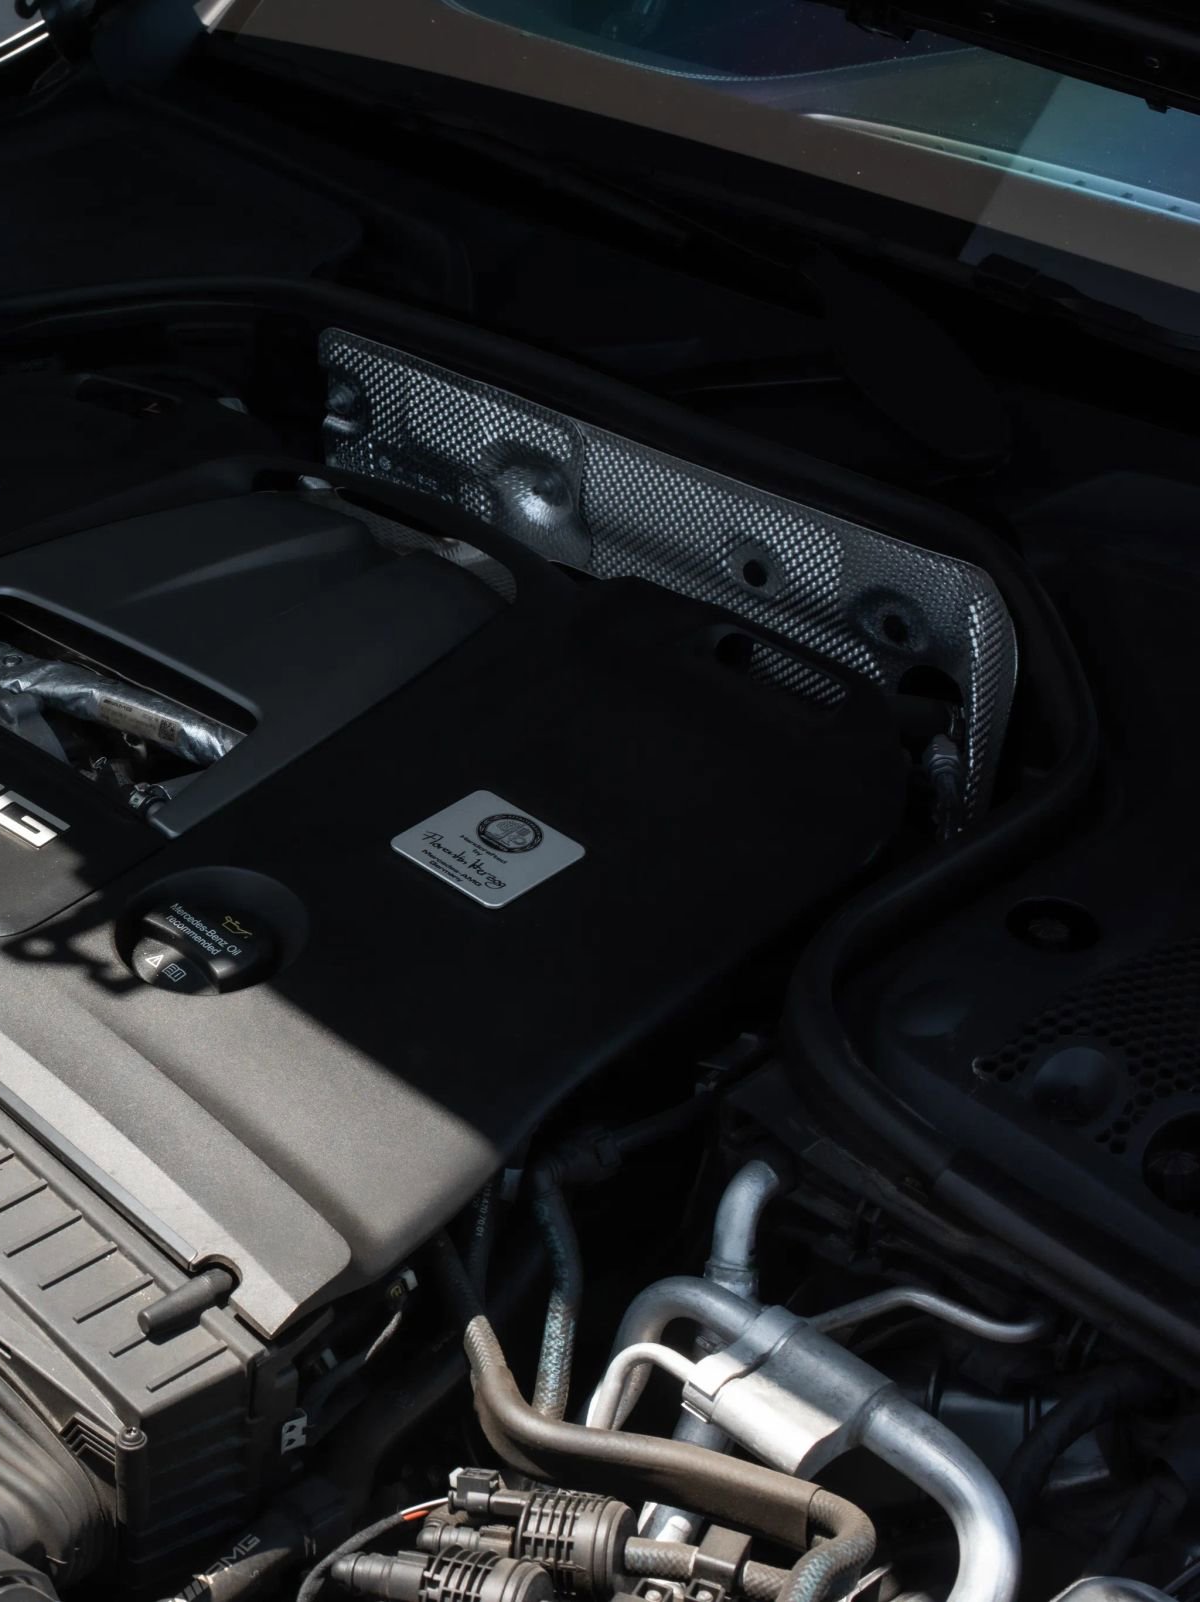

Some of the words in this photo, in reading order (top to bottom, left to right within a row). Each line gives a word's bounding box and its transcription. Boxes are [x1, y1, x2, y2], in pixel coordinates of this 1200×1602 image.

[429, 860, 463, 882] Germany
[165, 914, 221, 956] recommended
[169, 902, 228, 948] Mercedes-Benz
[226, 944, 242, 956] Oil
[204, 1533, 261, 1585] AMG
